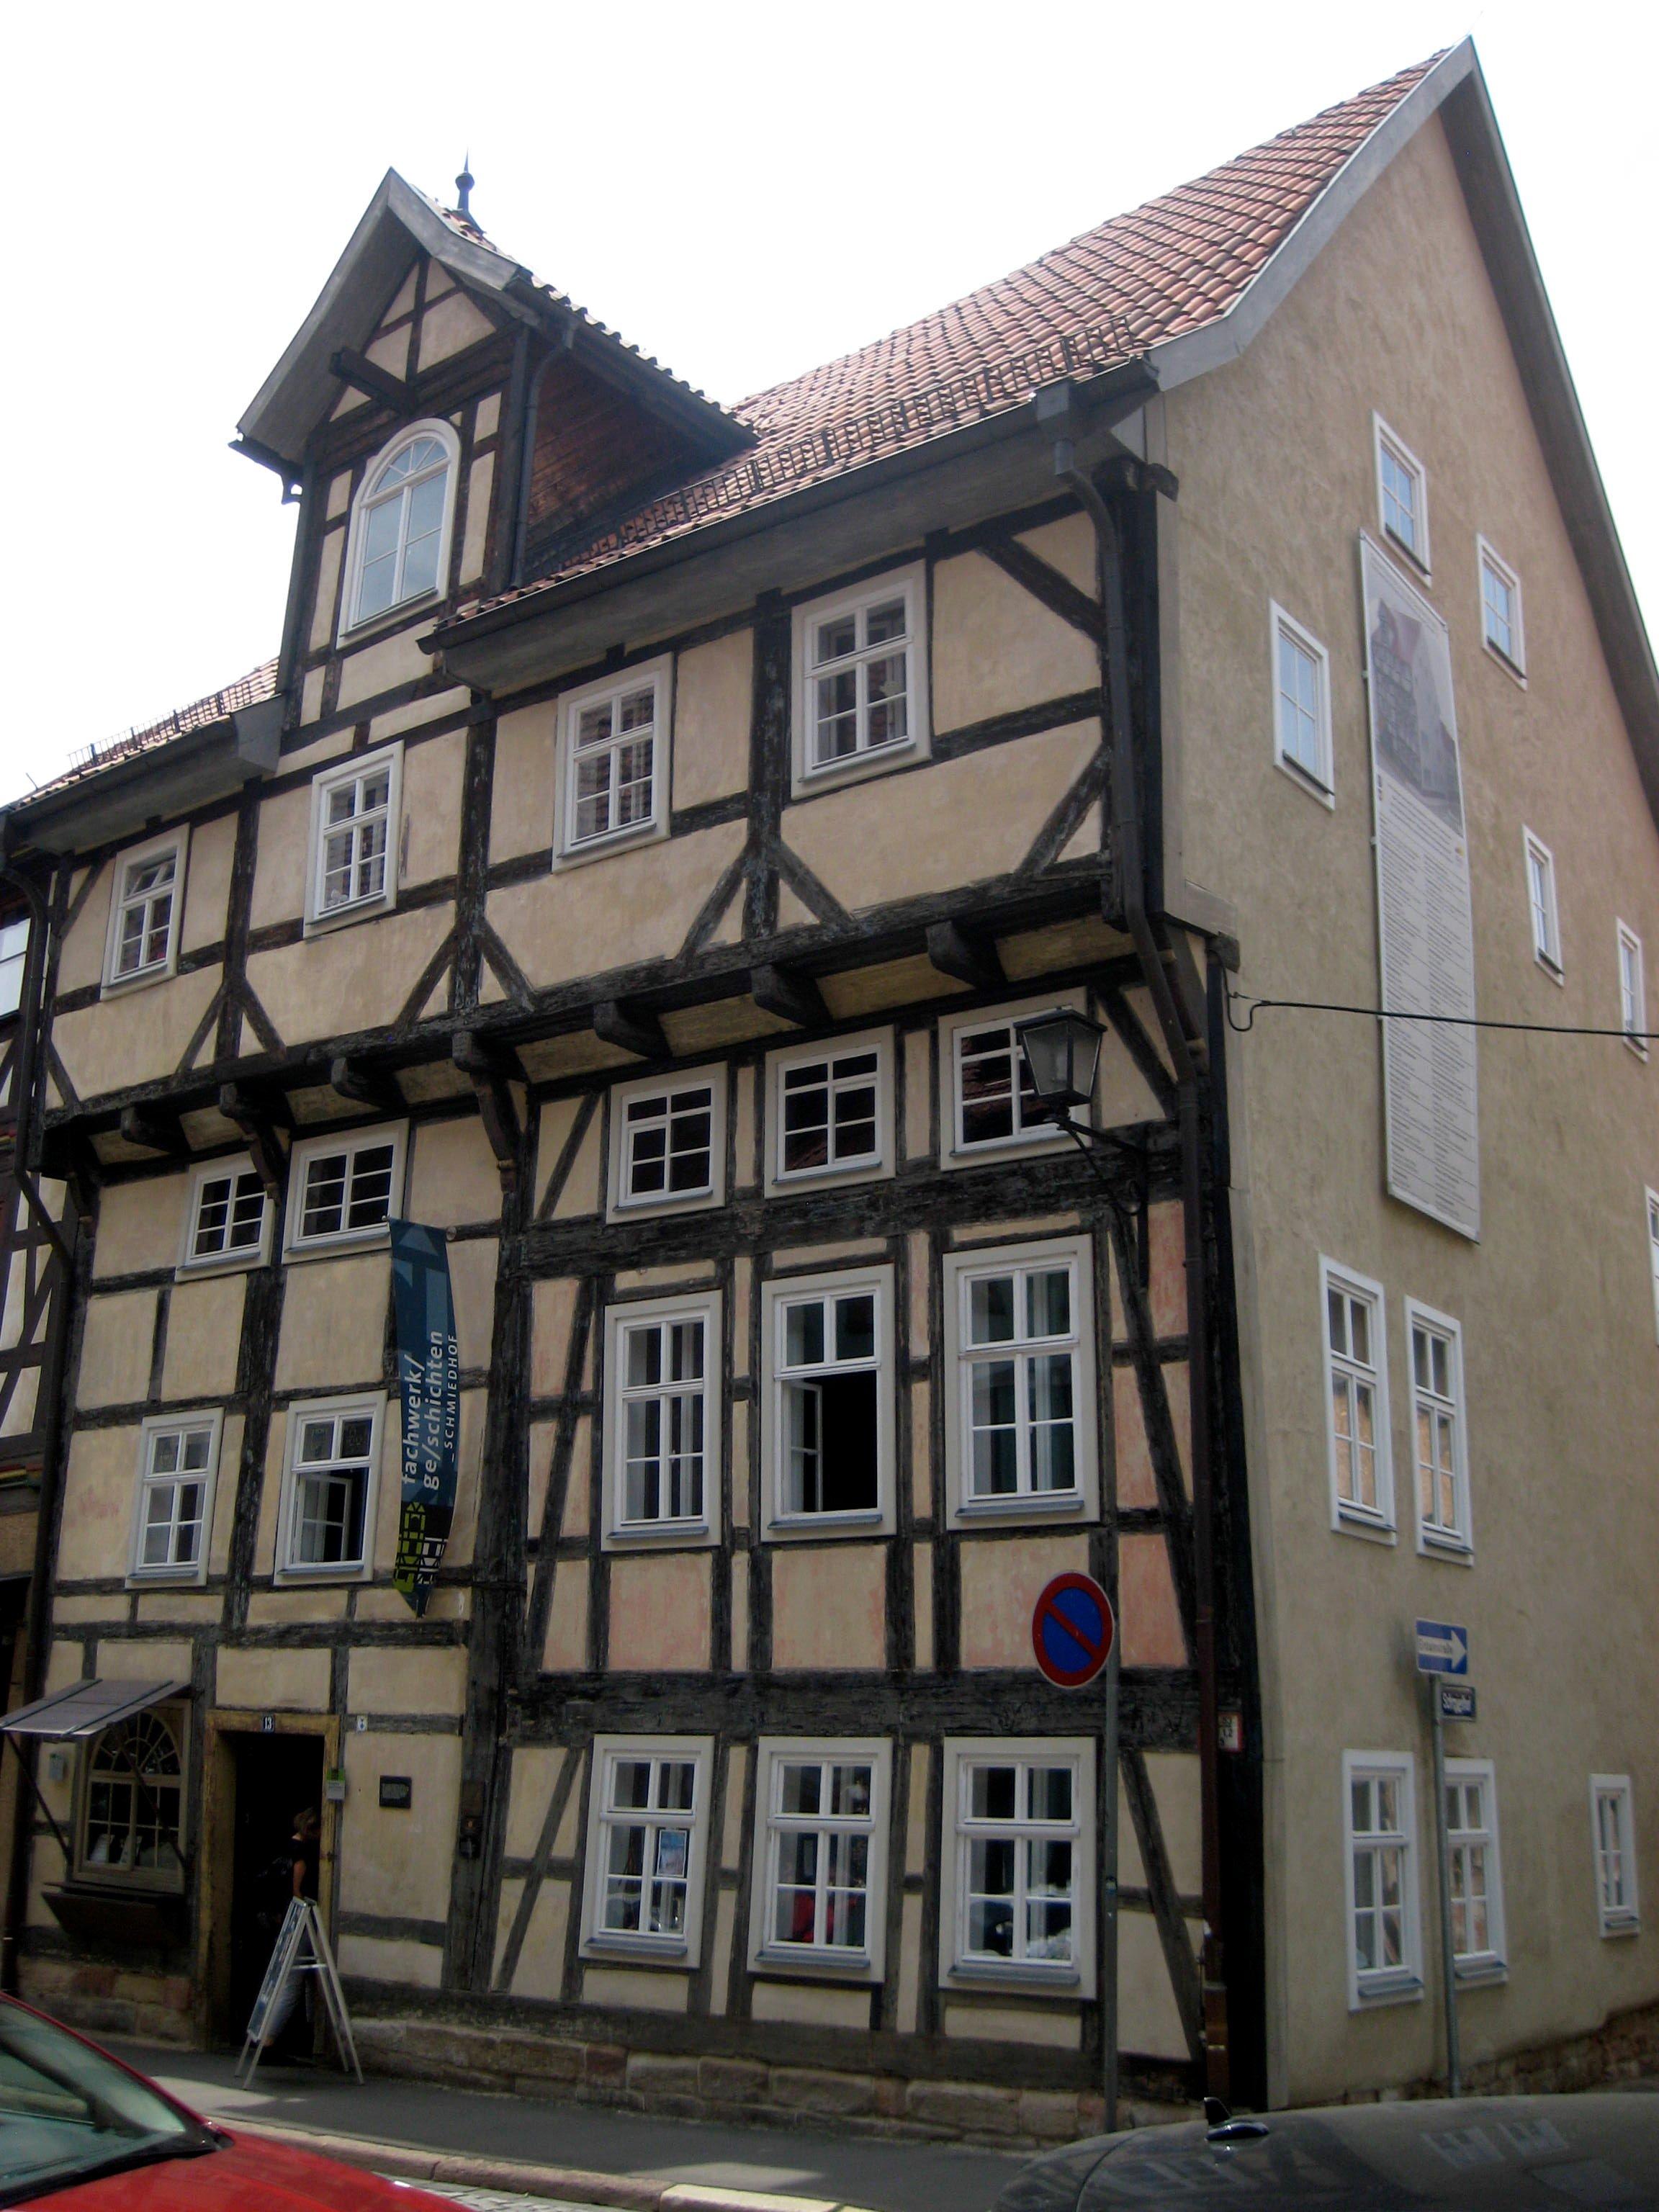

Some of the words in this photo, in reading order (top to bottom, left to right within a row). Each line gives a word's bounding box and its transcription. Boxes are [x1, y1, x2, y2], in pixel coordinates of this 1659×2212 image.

[402, 1354, 425, 1484] fachwerk/
[422, 1331, 443, 1491] ge/schichten
[264, 1716, 272, 1729] 13
